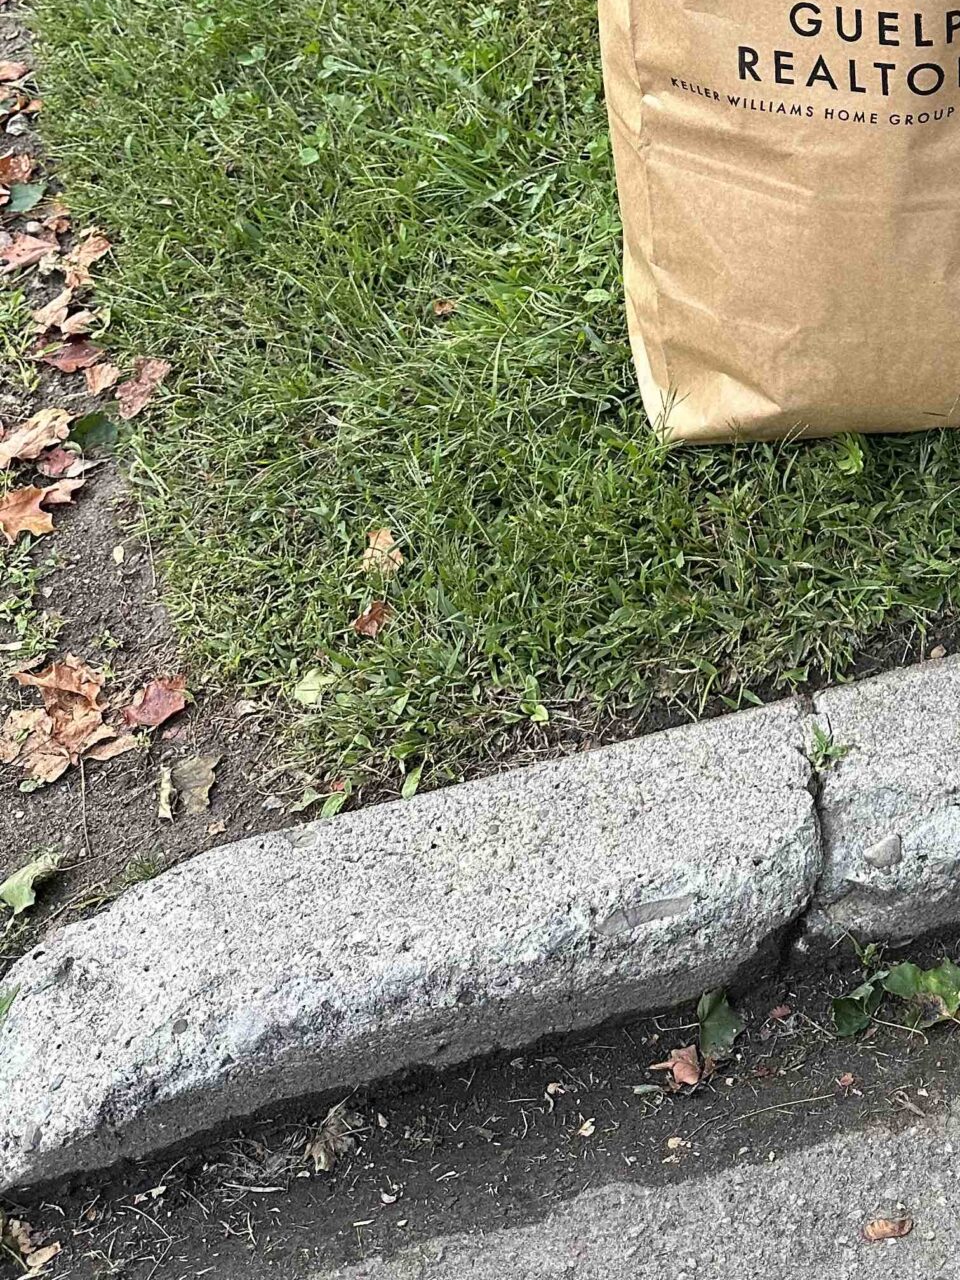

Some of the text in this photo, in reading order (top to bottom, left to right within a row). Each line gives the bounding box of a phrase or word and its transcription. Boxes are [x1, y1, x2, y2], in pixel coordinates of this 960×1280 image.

[670, 76, 721, 102] KELLER
[726, 94, 815, 118] WILLIAMS
[824, 107, 878, 126] HOME
[888, 105, 956, 127] GROUP
